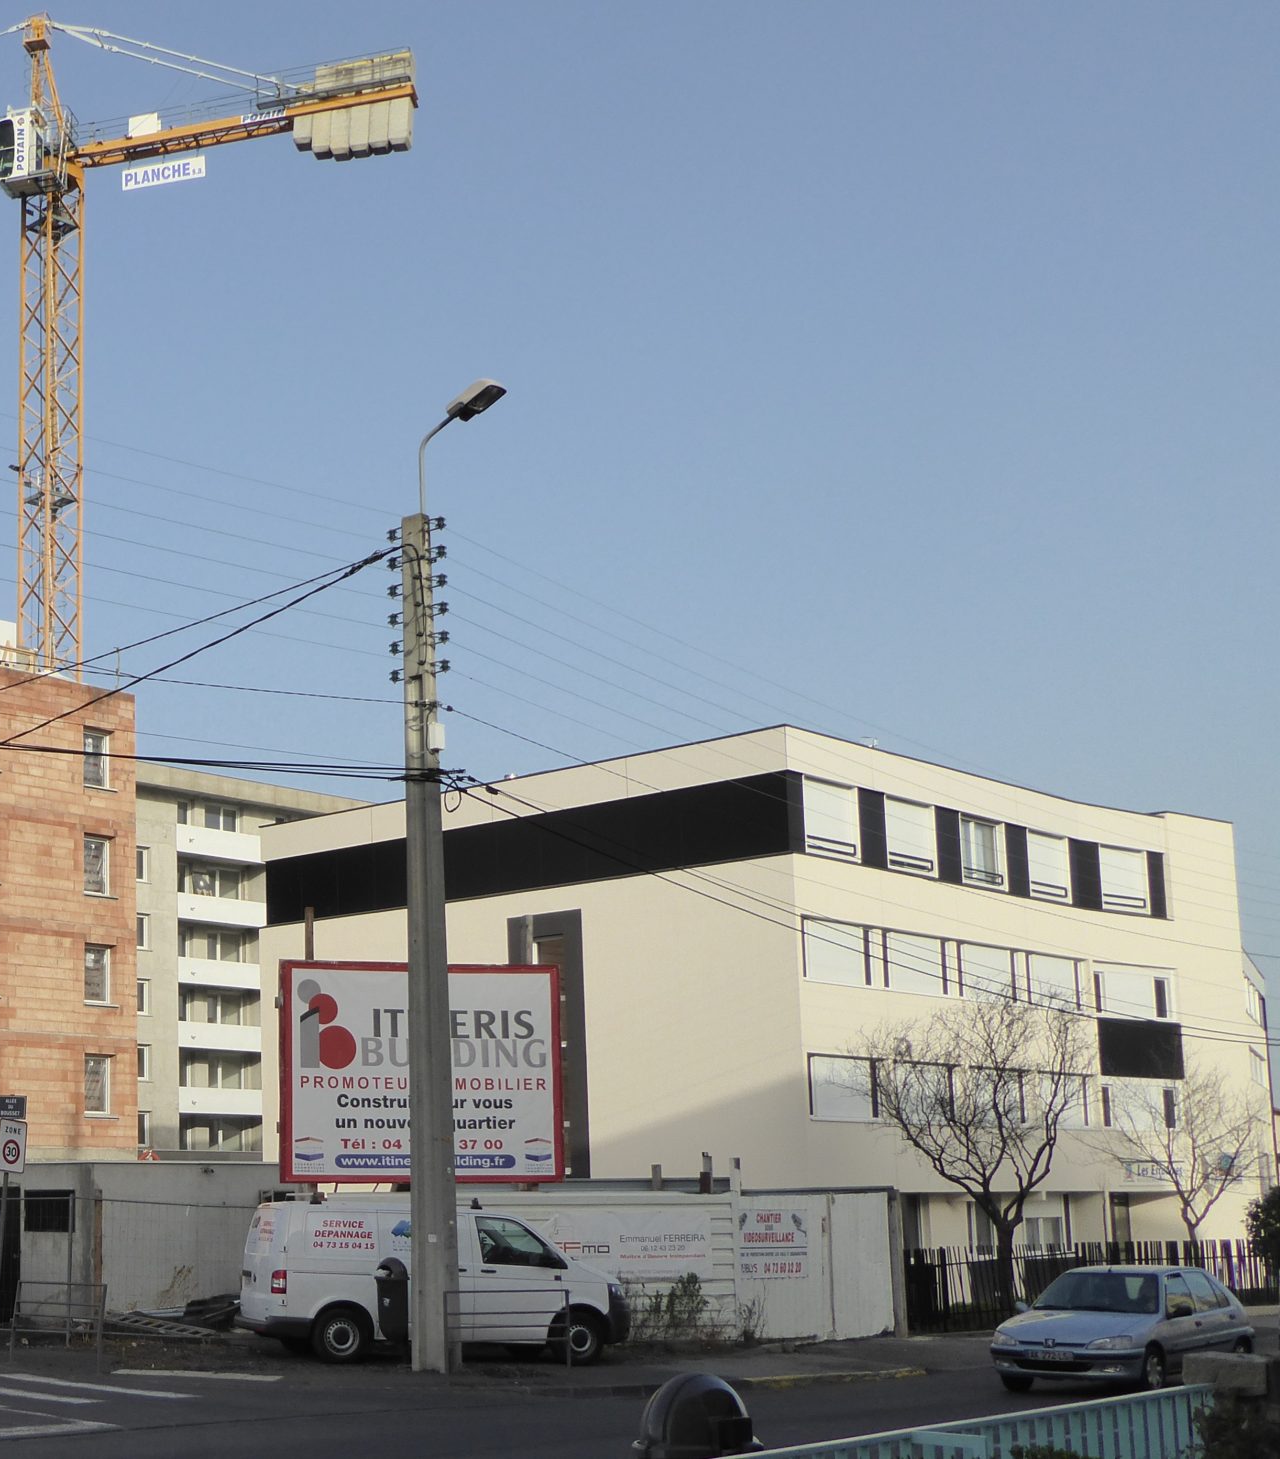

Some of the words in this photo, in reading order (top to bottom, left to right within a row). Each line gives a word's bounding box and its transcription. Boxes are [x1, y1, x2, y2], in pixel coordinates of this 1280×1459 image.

[16, 128, 25, 171] POTAIN
[124, 162, 191, 187] PLANCHE
[373, 1008, 534, 1039] ITERIS
[361, 1037, 547, 1068] BUDING
[300, 1075, 408, 1090] PROMOTEU
[455, 1078, 547, 1091] MOBILIER
[472, 1098, 513, 1109] vous
[335, 1118, 358, 1129] un
[364, 1118, 411, 1129] nouv
[5, 1126, 22, 1135] ZONE
[340, 1138, 366, 1150] Tél
[382, 1138, 402, 1150] 04
[458, 1139, 478, 1150] 37
[483, 1139, 503, 1150] 00
[6, 1146, 17, 1157] 30
[322, 1219, 365, 1229] SERVICE
[756, 1212, 782, 1224] CHANTIER
[314, 1229, 373, 1239] DEPANNAGE
[620, 1234, 662, 1243] Emmanuel
[663, 1233, 706, 1242] FERREIRA
[743, 1231, 795, 1243] VIDEOSURVEILLANCE
[312, 1240, 324, 1249] 04
[326, 1241, 337, 1249] 73
[339, 1241, 350, 1249] 15
[351, 1241, 362, 1250] 04
[364, 1242, 375, 1250] 15
[764, 1262, 771, 1274] 04
[772, 1262, 779, 1274] 73
